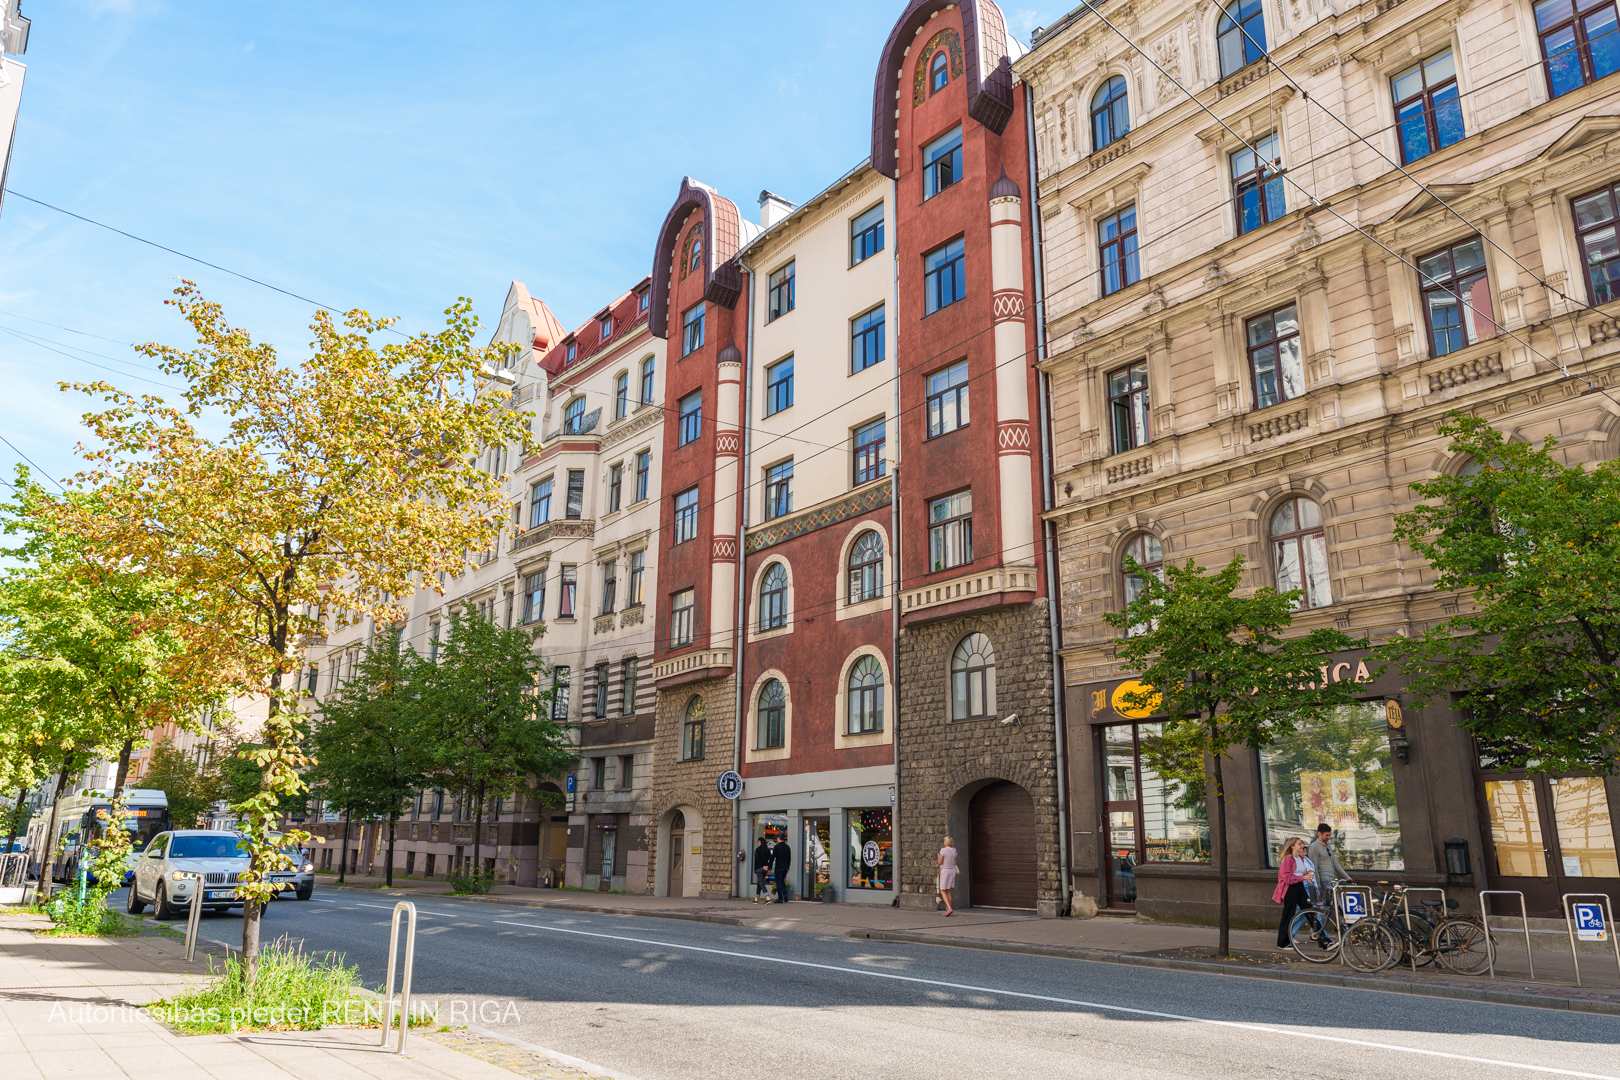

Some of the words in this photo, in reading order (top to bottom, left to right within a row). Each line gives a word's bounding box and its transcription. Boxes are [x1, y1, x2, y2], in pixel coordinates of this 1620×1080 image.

[1388, 705, 1402, 723] TĒJA
[1346, 895, 1358, 912] P
[1578, 908, 1593, 928] P
